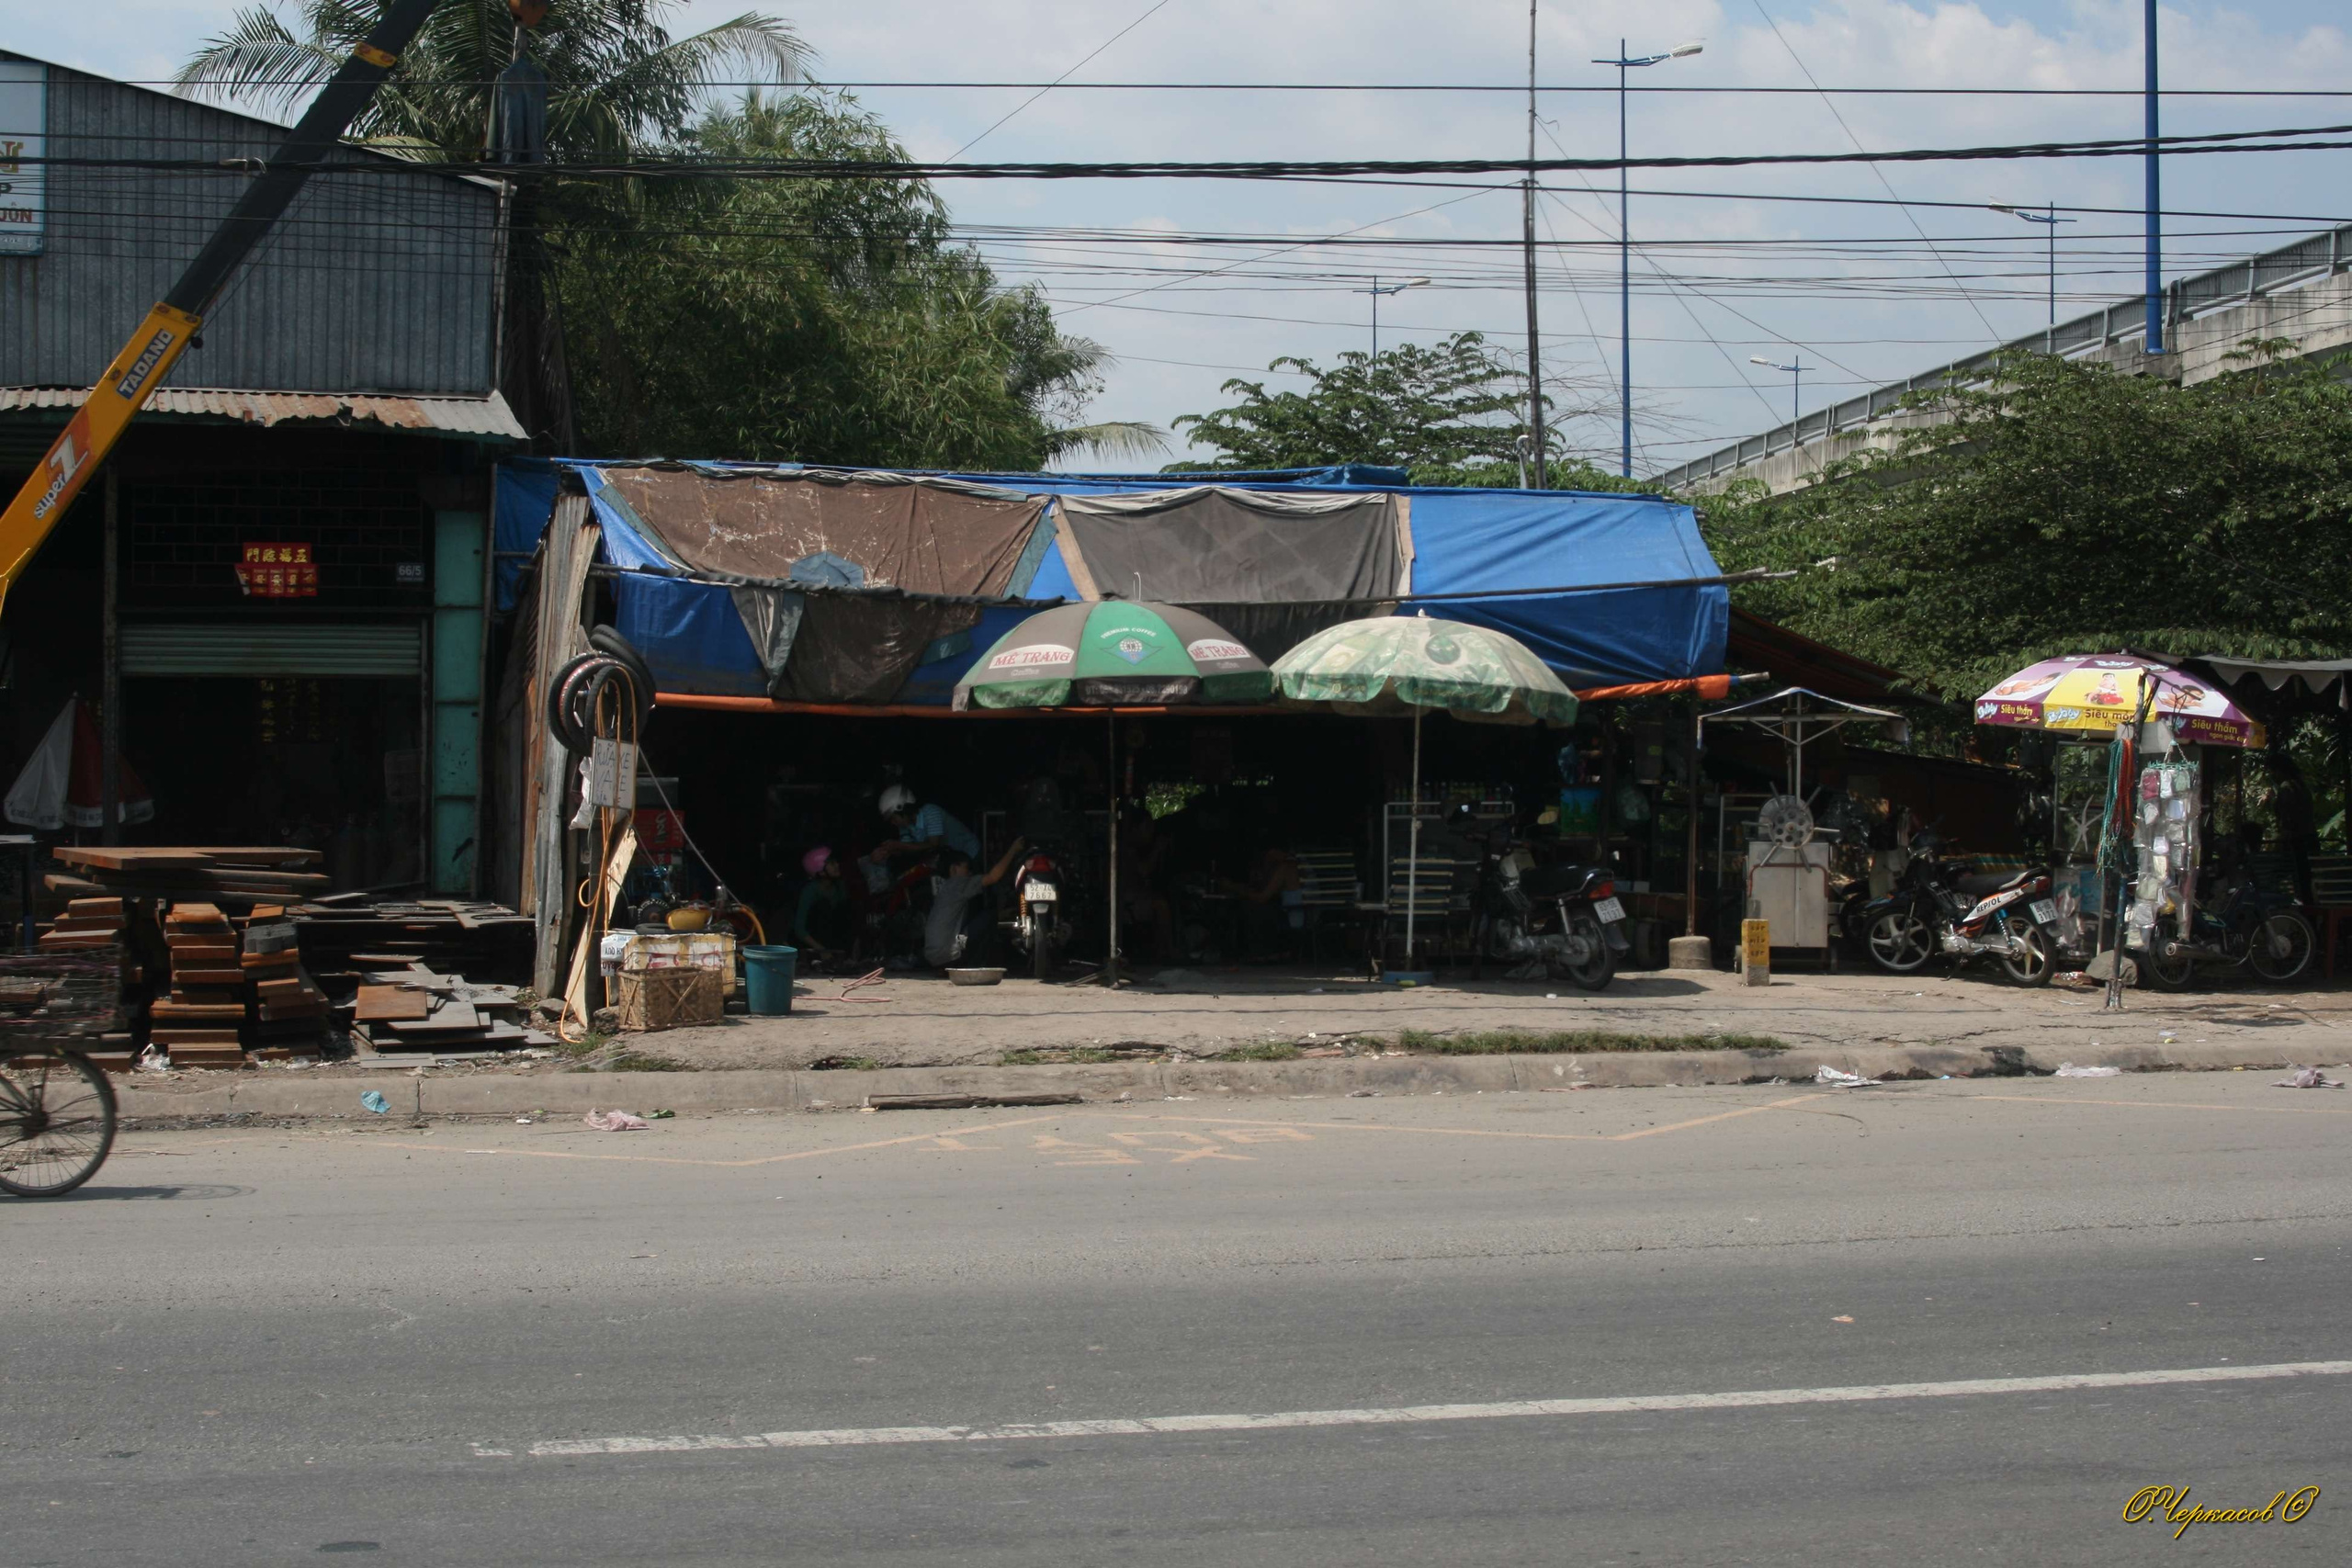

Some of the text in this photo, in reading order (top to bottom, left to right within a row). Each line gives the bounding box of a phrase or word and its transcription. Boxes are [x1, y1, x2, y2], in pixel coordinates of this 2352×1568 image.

[119, 330, 174, 394] TADANO
[34, 473, 65, 518] super
[399, 565, 422, 576] 66/5
[1100, 627, 1158, 639] PREMIUM COFFEE
[993, 650, 1071, 667] MÊ TRANG
[1205, 646, 1247, 658] TRANG
[2000, 704, 2016, 715] Siêu
[2085, 709, 2109, 719] Siêu
[2191, 718, 2211, 730] Siêu
[2214, 721, 2238, 734] thấm
[1976, 897, 2002, 914] REPSOL
